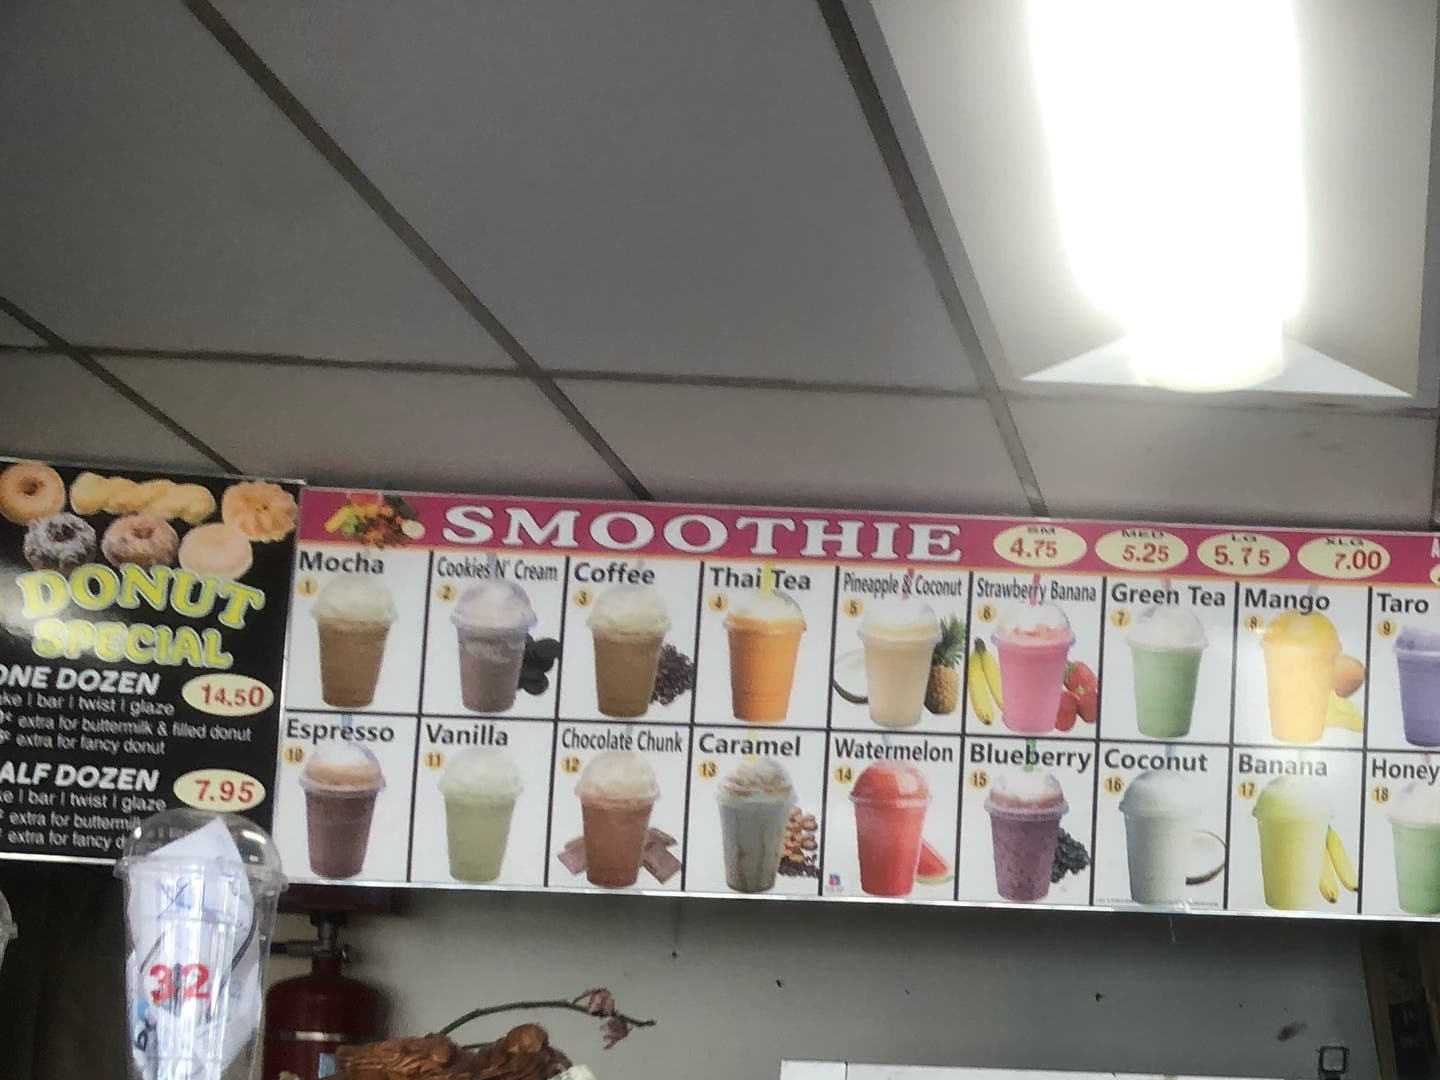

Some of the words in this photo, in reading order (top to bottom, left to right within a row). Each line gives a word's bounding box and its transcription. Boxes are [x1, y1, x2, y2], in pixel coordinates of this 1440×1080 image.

[442, 505, 963, 562] SMOOTHIE
[1009, 537, 1058, 558] 4.75
[1122, 543, 1170, 563] 5.25
[1333, 550, 1382, 571] 7.00
[299, 550, 385, 575] Mocha
[437, 556, 493, 578] Cookies
[514, 558, 558, 582] Cream
[573, 561, 656, 586] Coffee
[710, 566, 762, 590] Thai
[771, 569, 811, 592] Tea
[844, 572, 898, 599] Pineapple
[901, 574, 912, 596] &
[914, 574, 963, 597] Coconut
[977, 579, 1047, 605] Strawberry
[1051, 581, 1097, 602] Banana
[16, 562, 265, 630] DONUT
[1111, 582, 1179, 606] Green
[1186, 585, 1227, 608] Tea
[1244, 587, 1330, 613] Mango
[1376, 591, 1429, 615] Taro
[32, 618, 234, 669] SPECIAL
[56, 667, 161, 695] DOZEN
[201, 683, 265, 708] 14.50
[18, 715, 55, 731] extra
[82, 717, 152, 735] buttermilk
[157, 722, 168, 737] &
[172, 721, 207, 738] filled
[209, 724, 253, 743] donut
[285, 718, 395, 746] Espresso
[426, 724, 509, 748] Vanilla
[561, 727, 633, 752] Chocolate
[637, 730, 683, 754] Chunk
[16, 733, 53, 749] extra
[80, 735, 119, 755] fancy
[123, 738, 166, 755] donut
[698, 732, 801, 757] Caramel
[834, 738, 953, 762] Watermelon
[564, 756, 580, 773] 12
[969, 742, 1092, 773] Blueberry
[1104, 748, 1208, 774] Coconut
[1238, 752, 1329, 778] Banana
[55, 763, 160, 792] DOZEN
[973, 772, 988, 787] 15
[194, 779, 255, 803] 7.95
